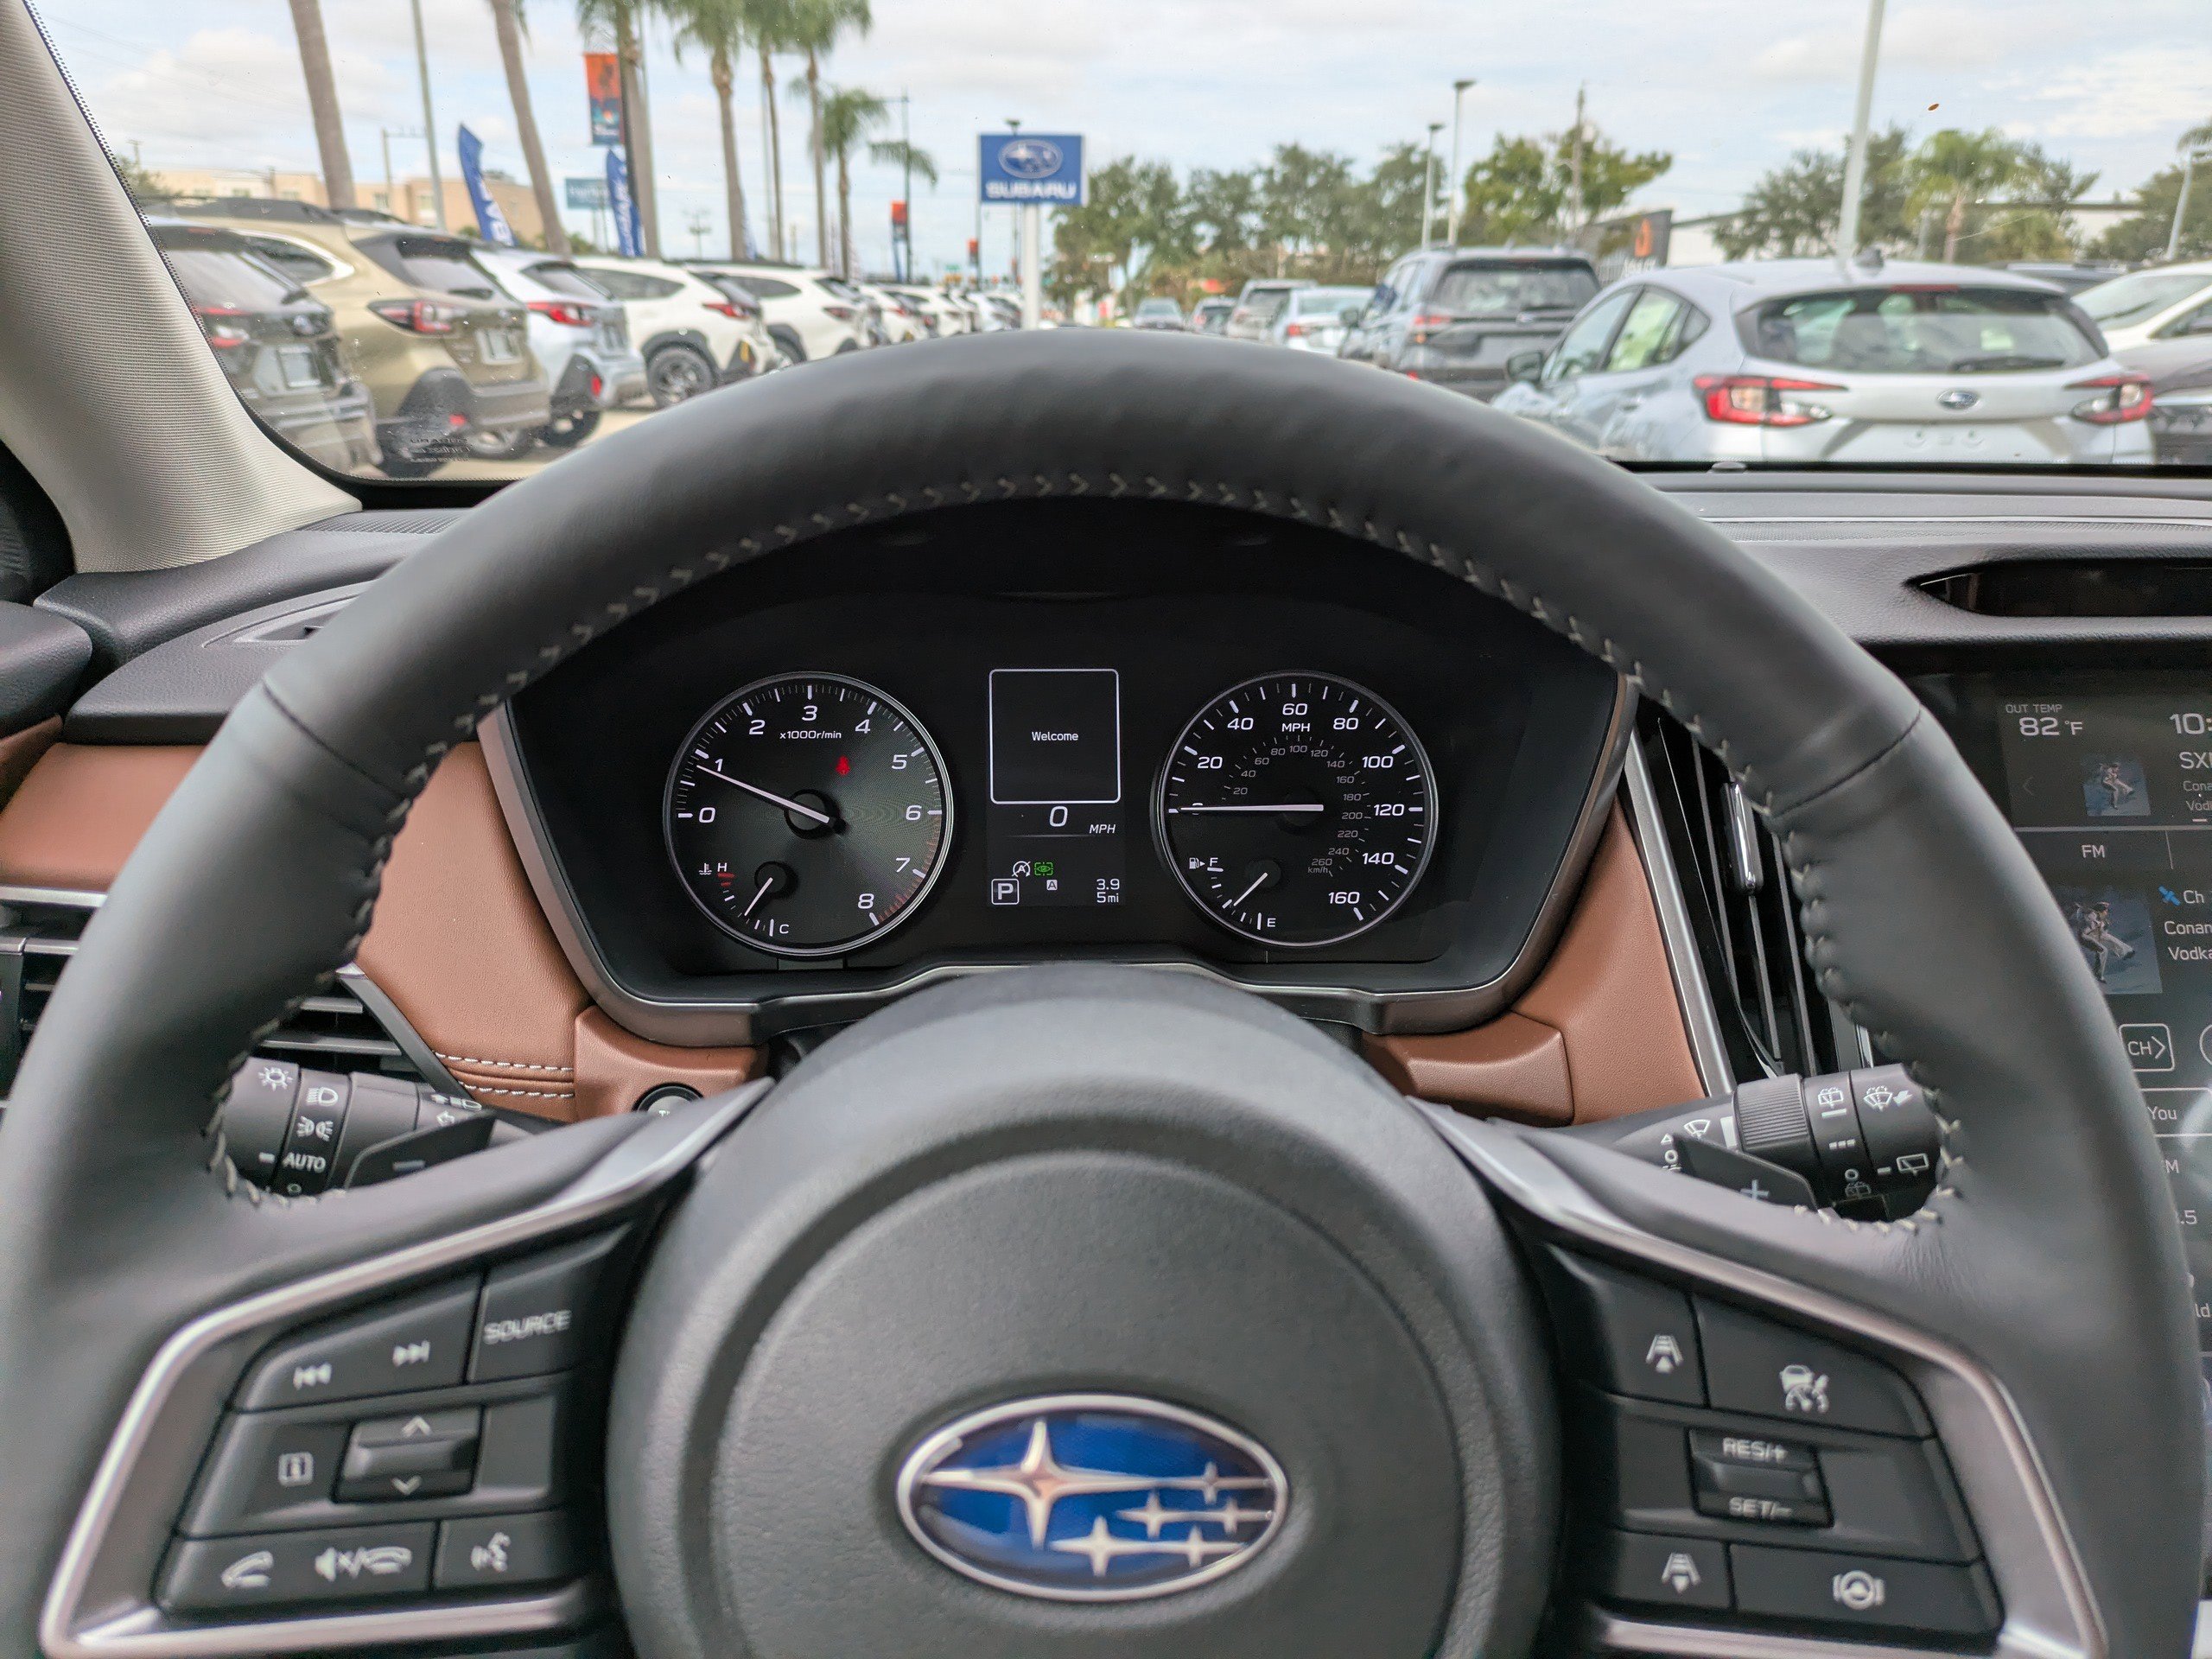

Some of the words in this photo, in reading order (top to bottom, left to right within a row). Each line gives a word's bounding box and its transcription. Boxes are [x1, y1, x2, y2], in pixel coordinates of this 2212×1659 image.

[985, 181, 1077, 200] SUBARU
[801, 705, 818, 721] 3
[1282, 702, 1308, 715] 60
[2005, 703, 2030, 714] OUT
[2032, 703, 2063, 714] TEMP
[748, 719, 766, 735] 2
[855, 718, 871, 734] 4
[1227, 717, 1254, 731] 40
[1281, 722, 1311, 733] MPH
[1332, 717, 1359, 730] 80
[2018, 716, 2061, 736] 82
[779, 730, 842, 741] x1000r/min
[1031, 731, 1079, 741] Welcome
[1270, 747, 1286, 756] 80
[1289, 745, 1308, 753] 100
[1310, 749, 1329, 758] 120
[714, 758, 723, 772] 1
[891, 753, 908, 770] 5
[1197, 756, 1224, 769] 20
[1254, 757, 1270, 766] 60
[1326, 760, 1345, 768] 140
[1362, 756, 1394, 769] 100
[2178, 751, 2212, 770] SX
[1336, 775, 1355, 784] 160
[1233, 786, 1249, 795] 20
[1343, 792, 1362, 801] 180
[698, 806, 716, 823] 0
[906, 804, 923, 821] 6
[1049, 805, 1068, 827] 0
[1341, 811, 1363, 820] 200
[1373, 804, 1405, 817] 120
[1089, 823, 1116, 834] MPH
[1337, 830, 1358, 838] 220
[1327, 847, 1350, 855] 240
[2081, 844, 2107, 859] FM
[895, 856, 911, 873] 7
[1209, 857, 1218, 868] F
[1311, 857, 1333, 866] 260
[1362, 852, 1395, 865] 140
[716, 862, 728, 872] H
[1307, 866, 1328, 874] km/h
[997, 882, 1014, 900] P
[1096, 878, 1120, 891] 3.9
[857, 893, 875, 910] 8
[1328, 891, 1361, 905] 160
[2183, 889, 2205, 904] Ch
[779, 924, 790, 934] C
[1267, 918, 1276, 928] E
[2164, 920, 2212, 935] Conan
[2127, 1040, 2152, 1056] CH
[2147, 1106, 2178, 1121] You
[282, 1152, 327, 1172] AUTO
[2163, 1159, 2180, 1174] M
[484, 1310, 571, 1345] SOURCE
